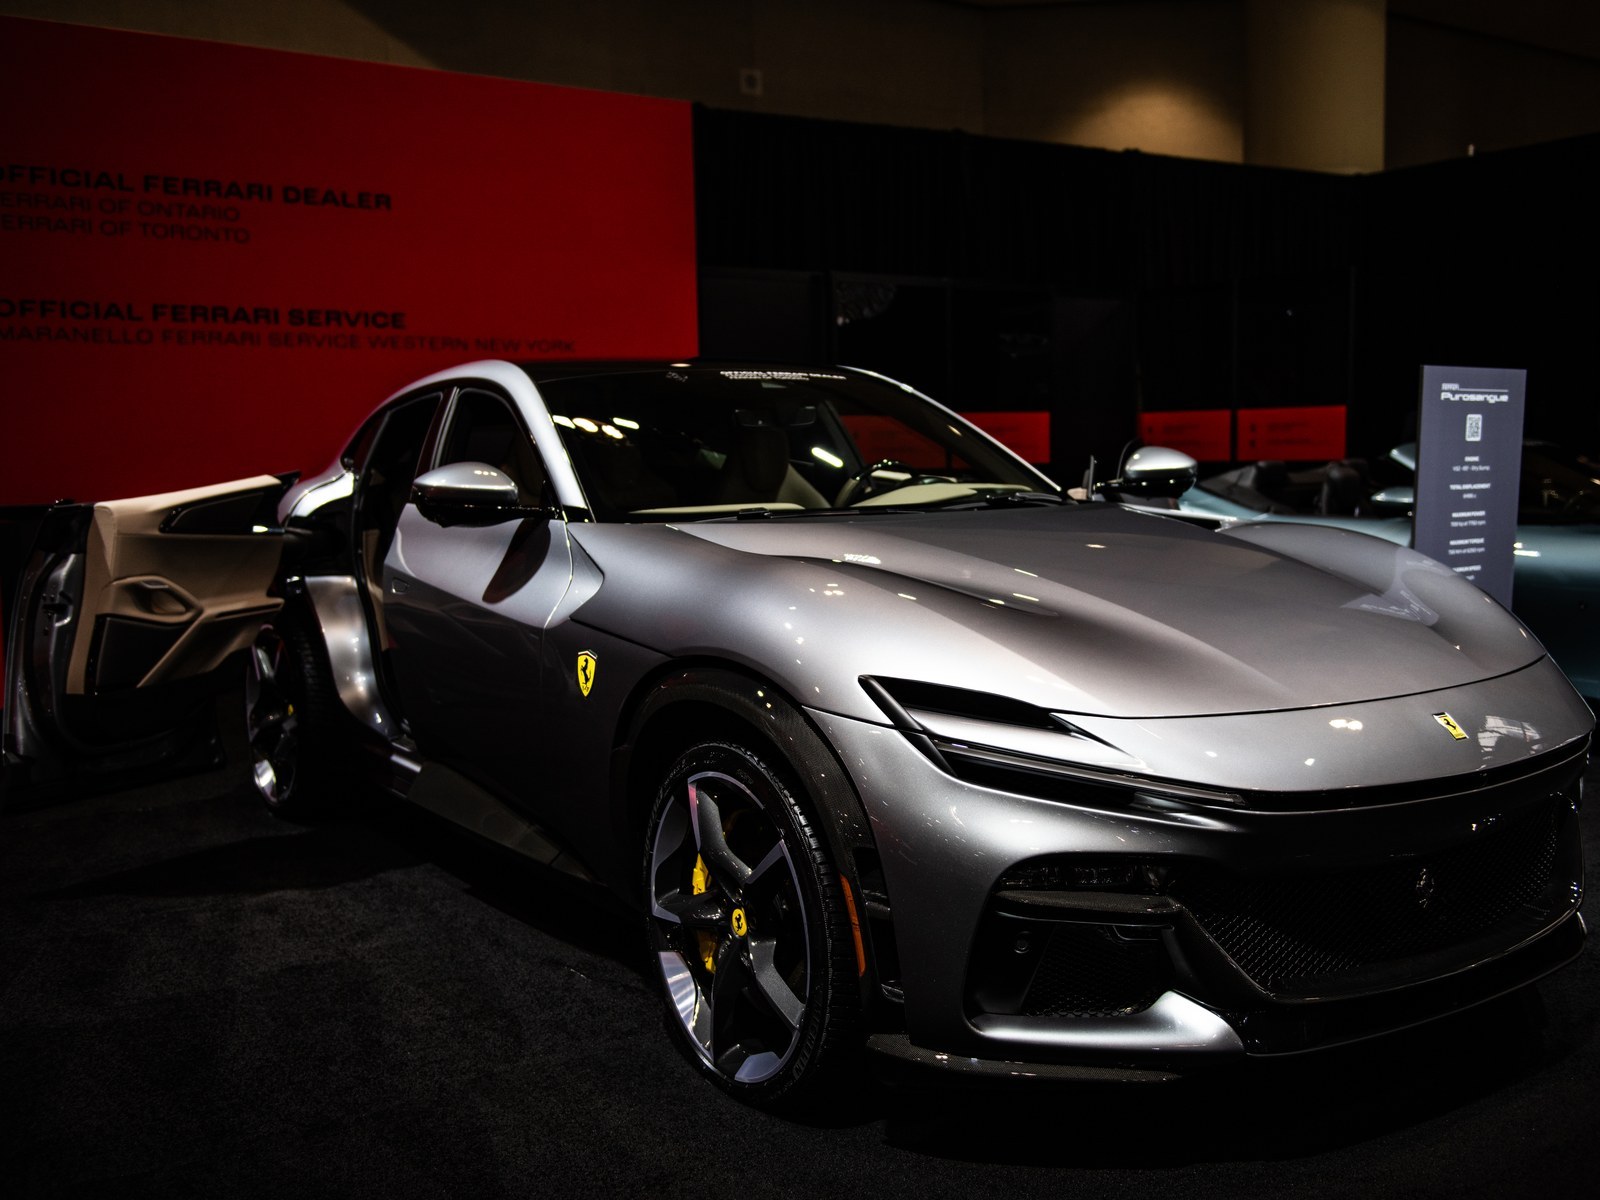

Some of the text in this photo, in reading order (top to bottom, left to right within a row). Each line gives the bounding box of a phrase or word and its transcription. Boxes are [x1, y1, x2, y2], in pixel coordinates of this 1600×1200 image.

[0, 164, 392, 212] FFICIAL FERRARI DEALER
[0, 192, 240, 222] ERRARI OF ONTARIO
[0, 213, 250, 244] ERRARI OF TORONTO
[0, 297, 407, 330] OFFICIAL FERRARI SERVICE
[161, 328, 261, 347] FERRARI
[268, 331, 359, 350] SERVICE
[367, 335, 469, 352] WESTERN
[475, 336, 522, 352] NEW
[526, 339, 575, 353] YORK
[1440, 391, 1509, 404] Purosangue
